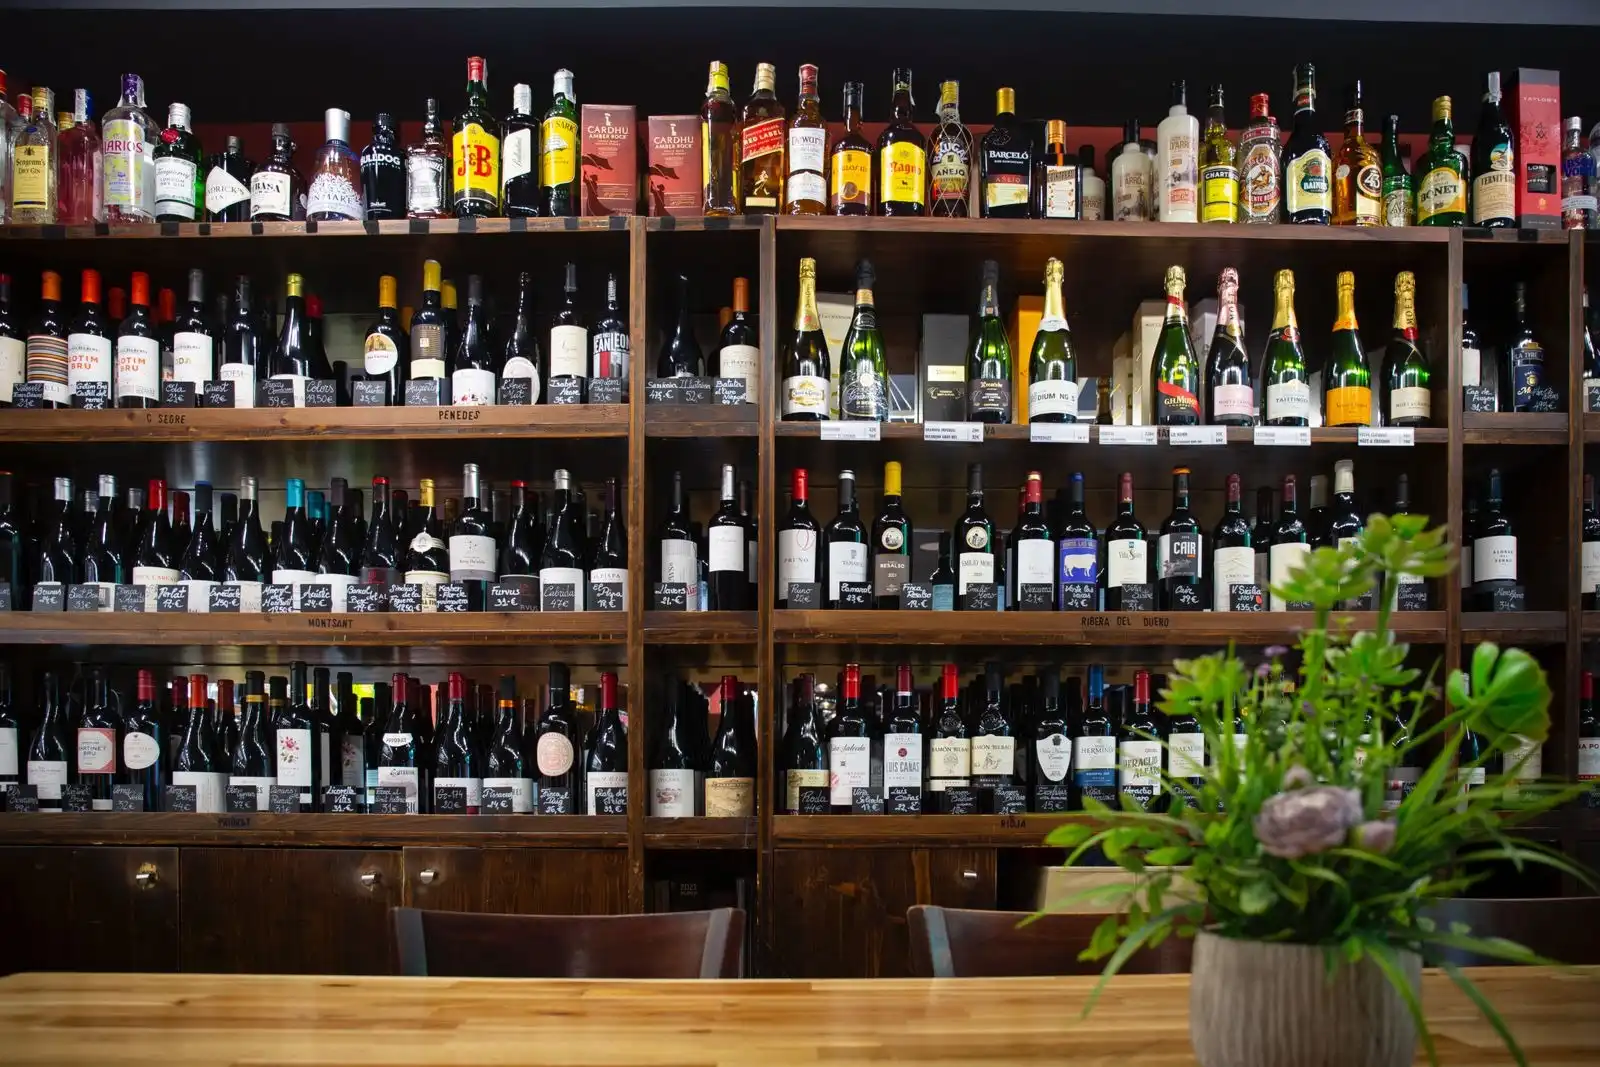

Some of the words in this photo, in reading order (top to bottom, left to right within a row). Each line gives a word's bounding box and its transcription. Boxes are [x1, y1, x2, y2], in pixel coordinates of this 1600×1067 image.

[587, 126, 629, 135] CARDHU
[653, 136, 694, 145] CARDHU
[457, 144, 492, 177] J&B
[989, 151, 1029, 160] BARCELÓ
[158, 417, 185, 427] SEGRE
[439, 410, 481, 423] PENEDES
[1173, 541, 1197, 555] CAIR
[491, 586, 521, 597] Furvus
[308, 618, 353, 629] MONTSANT
[1081, 616, 1109, 628] RIBERA
[1116, 616, 1132, 627] DEL
[1143, 617, 1170, 629] DUERO
